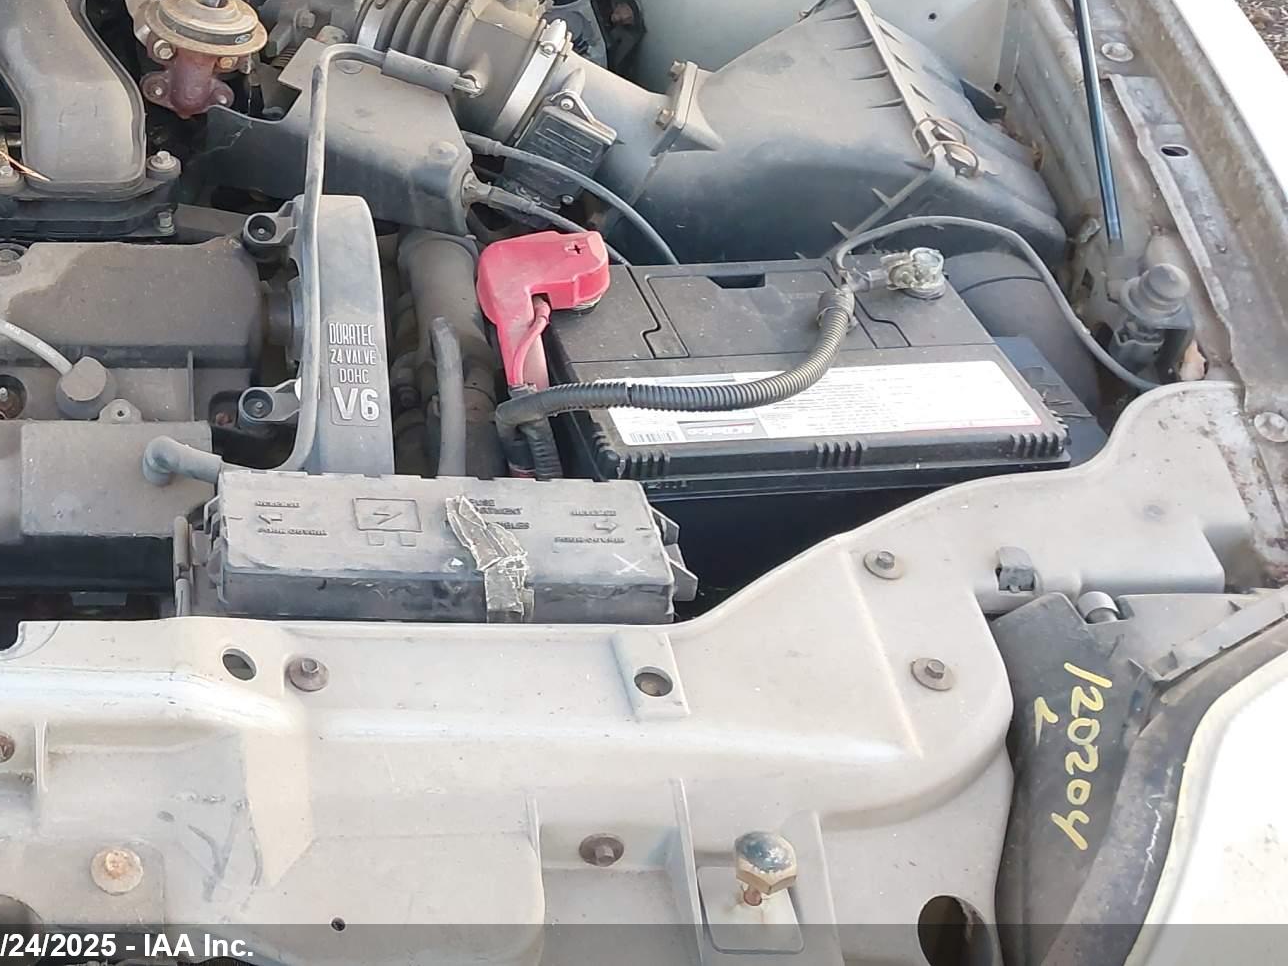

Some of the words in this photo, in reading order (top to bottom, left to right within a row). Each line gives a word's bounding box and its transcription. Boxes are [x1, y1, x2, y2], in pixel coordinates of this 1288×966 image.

[328, 322, 375, 346] DURATEC
[330, 349, 343, 364] 24
[344, 349, 377, 365] VALVE
[339, 368, 369, 383] DOHC
[333, 386, 380, 421] V6
